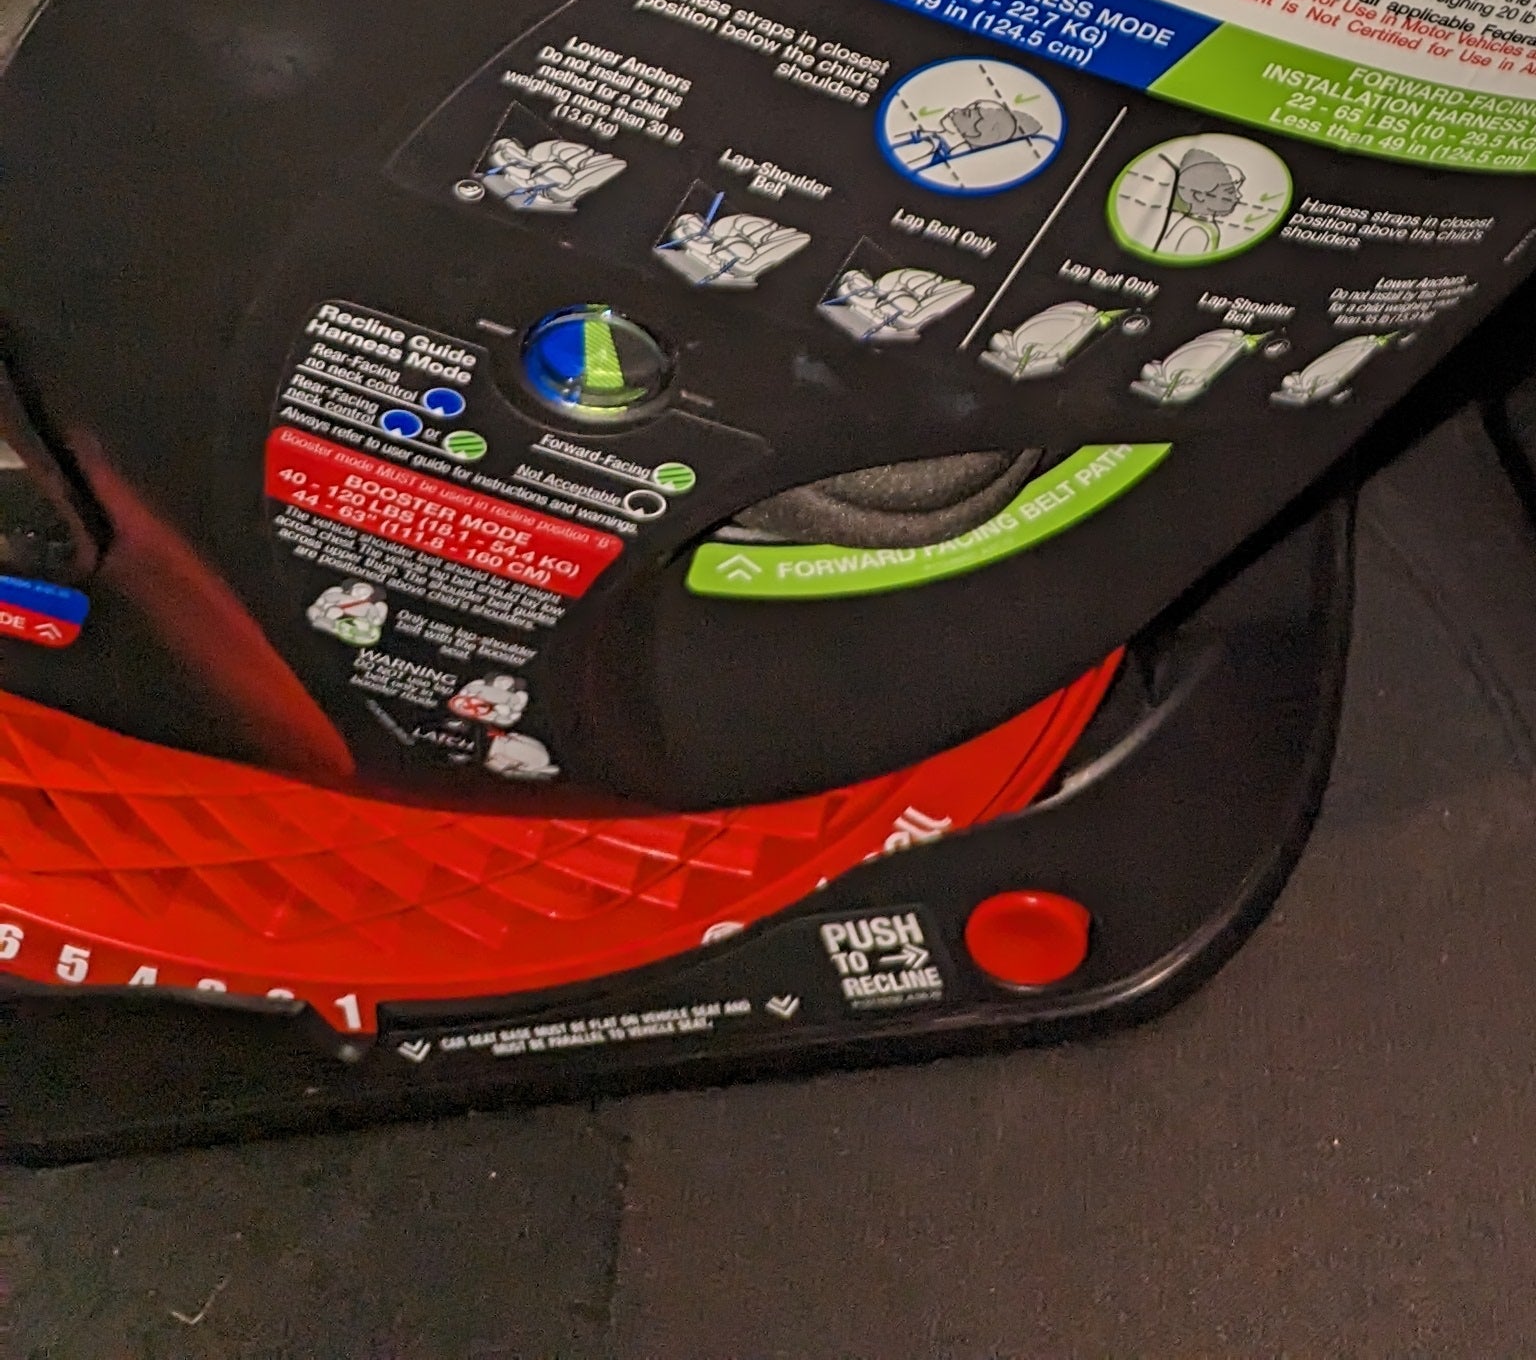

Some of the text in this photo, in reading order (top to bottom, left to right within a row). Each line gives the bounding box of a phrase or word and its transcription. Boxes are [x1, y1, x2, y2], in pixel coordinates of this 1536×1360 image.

[944, 0, 967, 20] in
[972, 10, 1045, 46] (124.5
[1048, 41, 1093, 66] cm)
[1006, 1, 1060, 28] 22.7
[1061, 19, 1107, 49] KG)
[1096, 8, 1175, 46] MODE
[1386, 2, 1475, 34] applicable
[565, 36, 692, 92] Lower Anchors
[719, 20, 781, 53] below
[782, 45, 815, 67] the
[817, 60, 879, 89] child's
[728, 10, 795, 40] straps
[796, 30, 817, 49] in
[819, 42, 890, 75] closest
[538, 65, 669, 119] method for a child
[539, 46, 683, 107] Do not install by this
[776, 63, 870, 104] shoulders
[1262, 63, 1425, 117] INSTALLATION
[1426, 106, 1529, 133] HARNESS
[504, 71, 684, 142] weighing more than 30 lb
[554, 103, 618, 137] (13.6 kg)
[1286, 92, 1317, 111] 22
[1334, 105, 1364, 123] 65
[1364, 114, 1410, 133] LBS
[1410, 123, 1445, 140] (10
[1460, 131, 1505, 148] 29.5
[1269, 107, 1531, 169] Less than 49 in (124.5 cm)
[719, 148, 832, 197] Lap-Shoulder
[751, 175, 786, 196] Belt
[891, 208, 997, 254] Lap Belt Only
[1281, 226, 1360, 247] shoulders
[1289, 213, 1484, 241] position above the child's
[1300, 197, 1494, 229] Harness straps in closest
[1059, 259, 1159, 297] Lap Belt Only
[1198, 292, 1295, 317] Lap-Shoulder
[1224, 309, 1254, 324] Belt
[306, 319, 471, 383] Harness Mode
[318, 305, 476, 367] Recline Guide
[303, 355, 419, 402] no neck control
[311, 342, 400, 383] Rear-Facing
[284, 385, 377, 425] neck control
[290, 374, 379, 414] Rear-Facing
[423, 428, 441, 441] or
[538, 430, 654, 481] Forward-Facing
[280, 406, 330, 432] Always
[331, 426, 364, 443] refer
[365, 436, 380, 449] to
[381, 444, 412, 460] user
[412, 454, 451, 473] guide
[452, 465, 472, 480] for
[472, 473, 548, 506] instructions
[549, 499, 577, 514] and
[516, 461, 624, 507] Not Acceptable
[279, 469, 307, 485] 40
[329, 486, 366, 506] 120
[368, 500, 415, 523] LBS
[418, 512, 469, 542] (18.1
[490, 540, 535, 563] 54.4
[538, 555, 579, 578] KG)
[344, 475, 532, 545] BOOSTER MODE
[778, 548, 916, 580] FORWARD
[1018, 483, 1077, 522] BELT
[1077, 443, 1134, 488] PATH
[292, 490, 319, 506] 44
[338, 506, 377, 522] 63"
[380, 520, 445, 549] (111.8
[467, 549, 503, 568] 160
[507, 562, 551, 585] CM)
[359, 648, 457, 686] WARNING
[820, 912, 925, 955] PUSH
[0, 923, 24, 960] 6
[56, 944, 91, 983] 5
[334, 993, 362, 1030] 1
[831, 952, 870, 976] TO
[841, 966, 944, 1000] RECLINE
